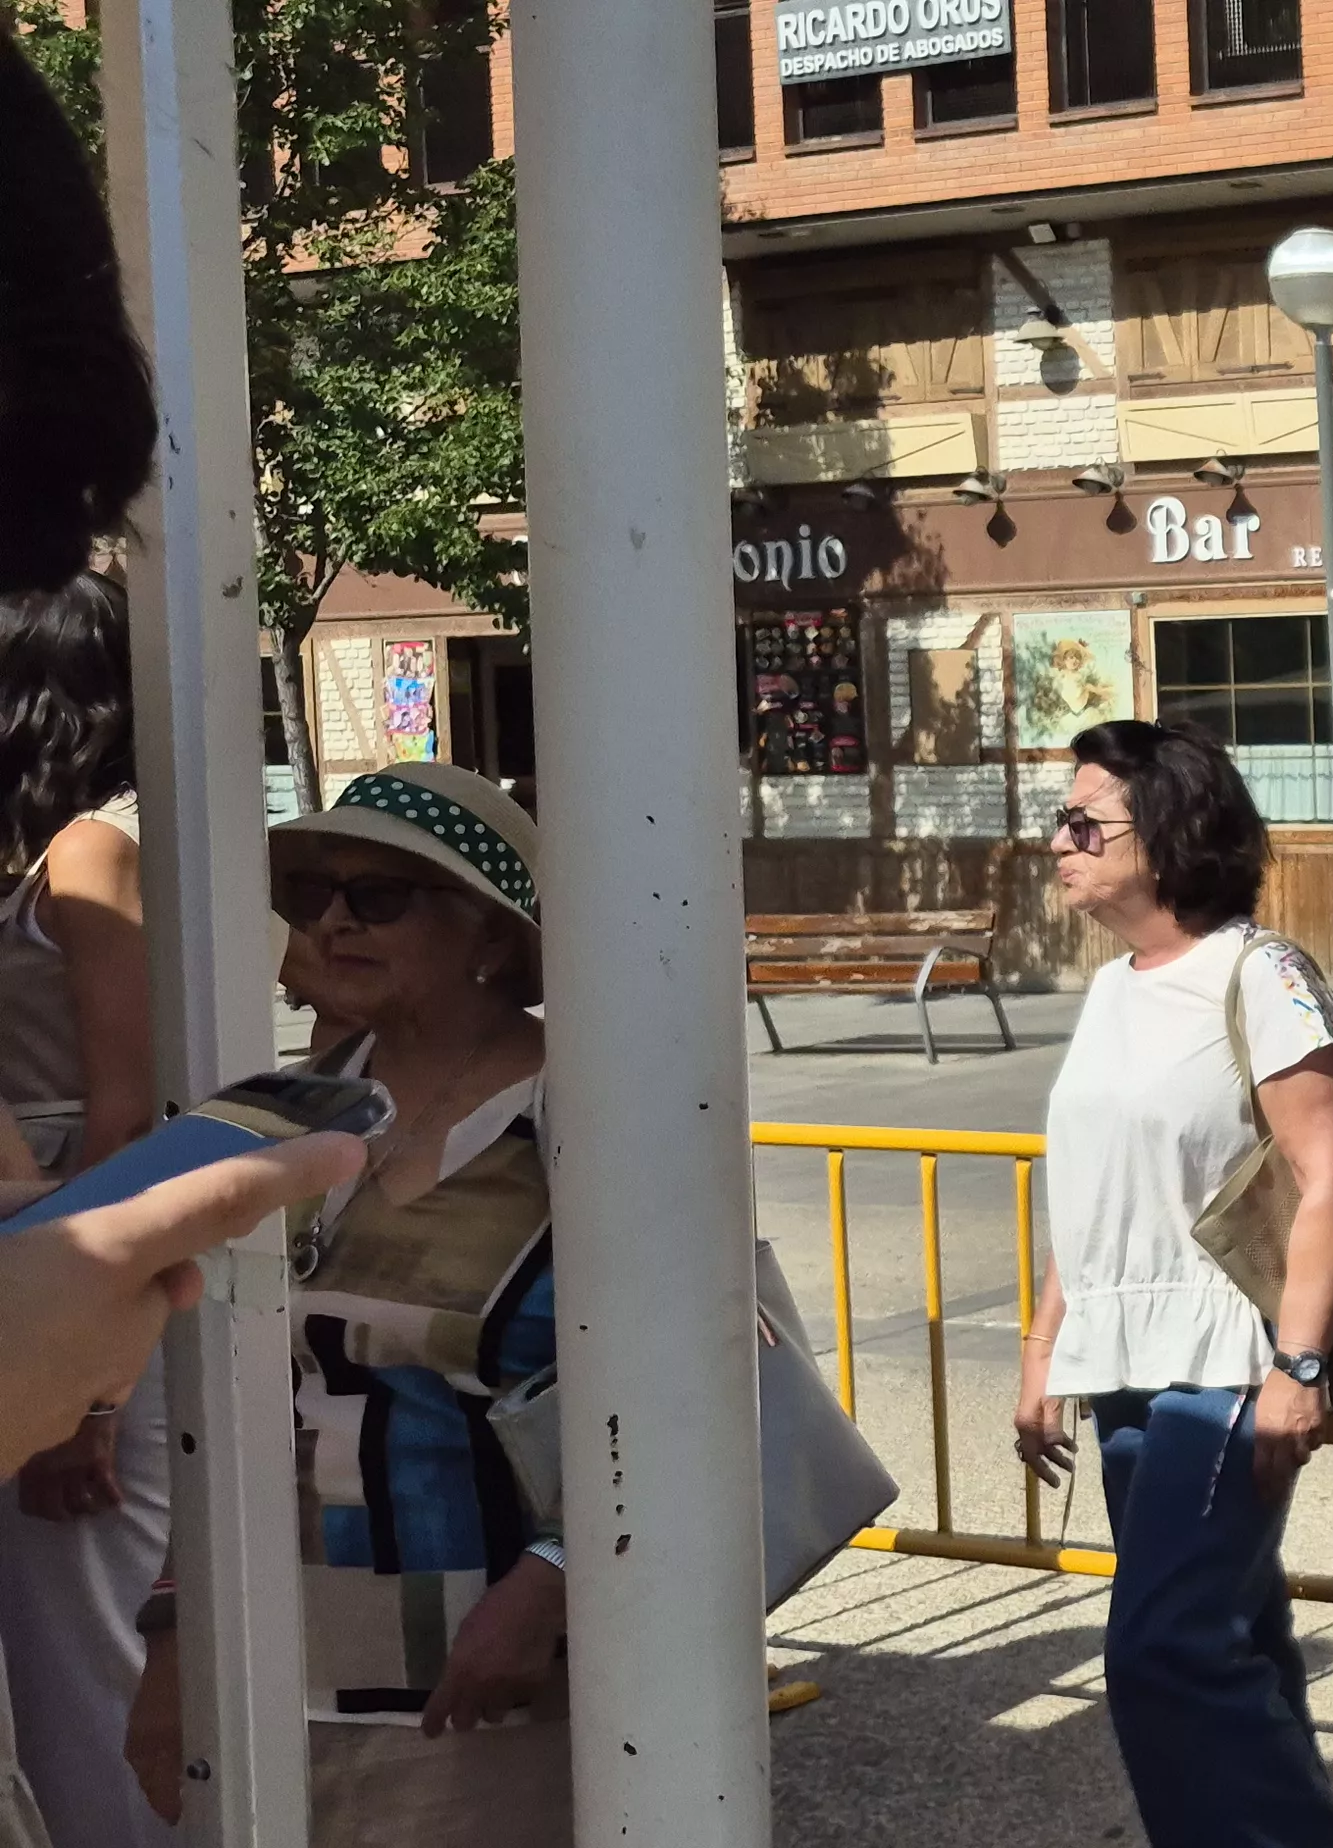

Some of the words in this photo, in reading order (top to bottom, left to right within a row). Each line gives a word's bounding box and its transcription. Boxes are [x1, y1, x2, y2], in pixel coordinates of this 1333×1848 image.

[777, 0, 910, 51] RICARDO
[780, 48, 873, 77] DESPACHO
[876, 41, 901, 64] DE
[904, 27, 1004, 60] ABOGADOS
[1147, 496, 1261, 563] Bar
